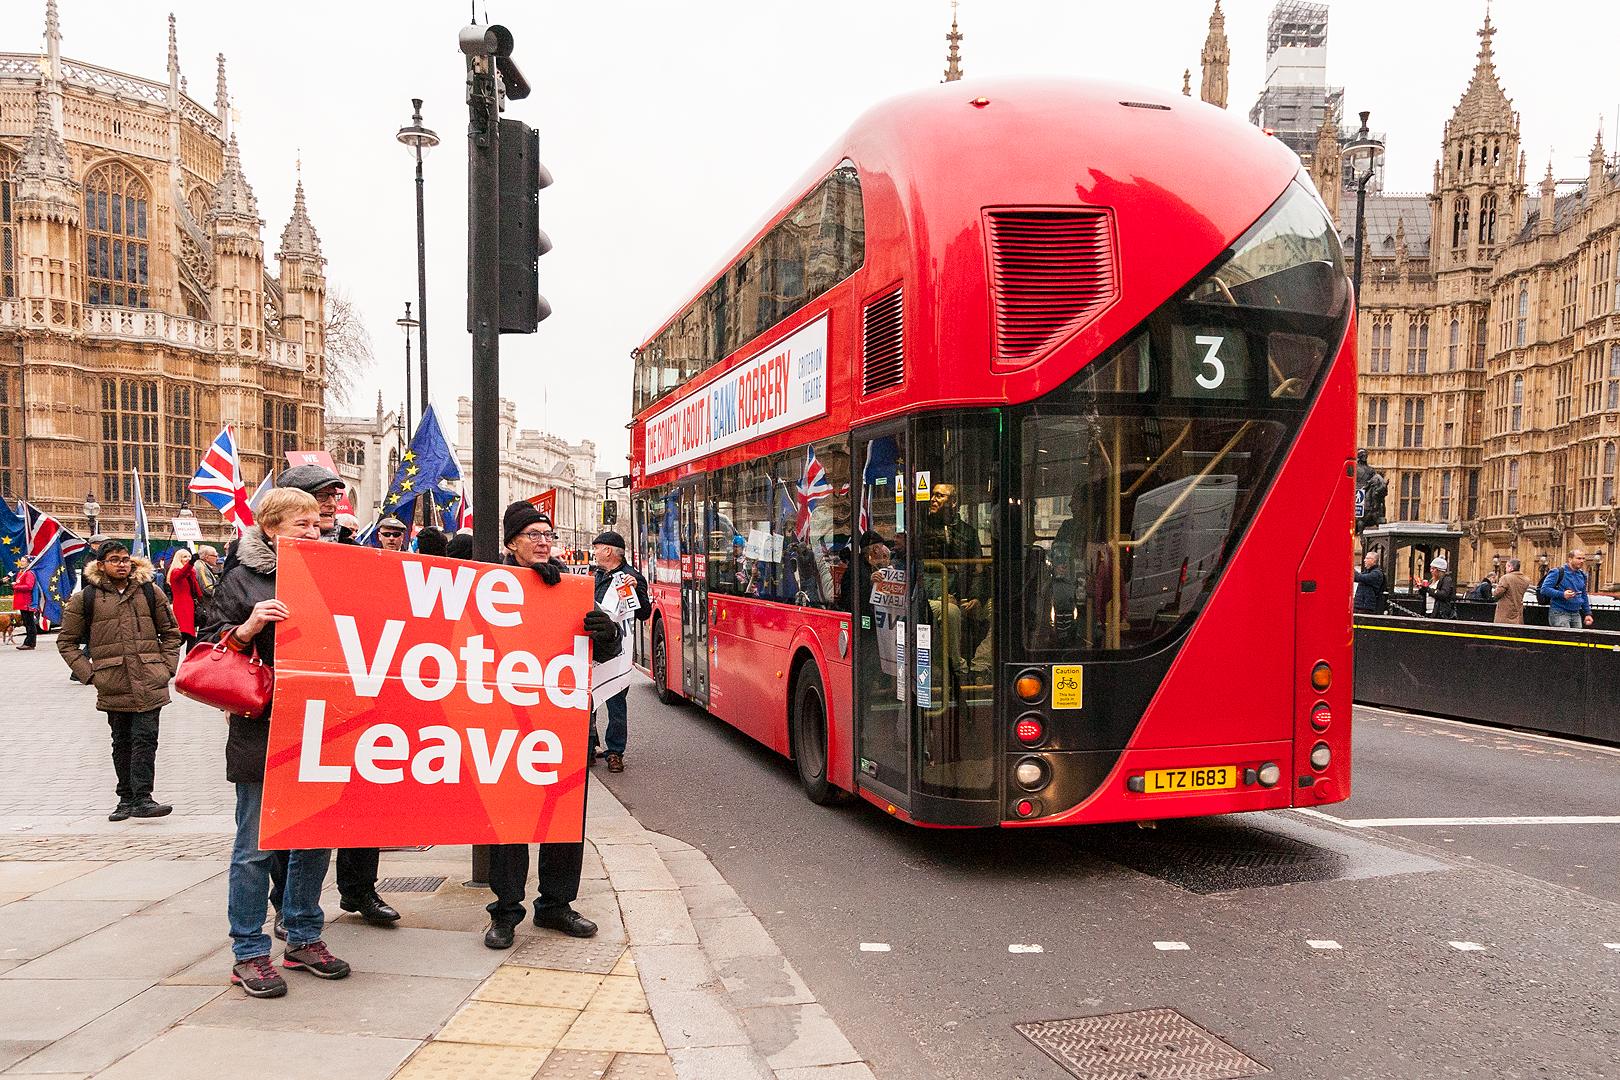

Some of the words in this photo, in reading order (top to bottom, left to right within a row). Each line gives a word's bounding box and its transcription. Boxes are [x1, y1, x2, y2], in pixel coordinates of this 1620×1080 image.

[1195, 335, 1225, 389] 3
[647, 425, 656, 465] THE
[658, 410, 681, 461] COMEDY
[682, 398, 704, 452] ABOUT
[714, 379, 737, 440] BANK
[739, 350, 790, 430] ROBBERY
[302, 454, 319, 462] WE
[333, 614, 590, 711] Voted
[298, 699, 563, 786] Leave
[1155, 771, 1187, 790] LTZ
[1191, 768, 1227, 787] 1683
